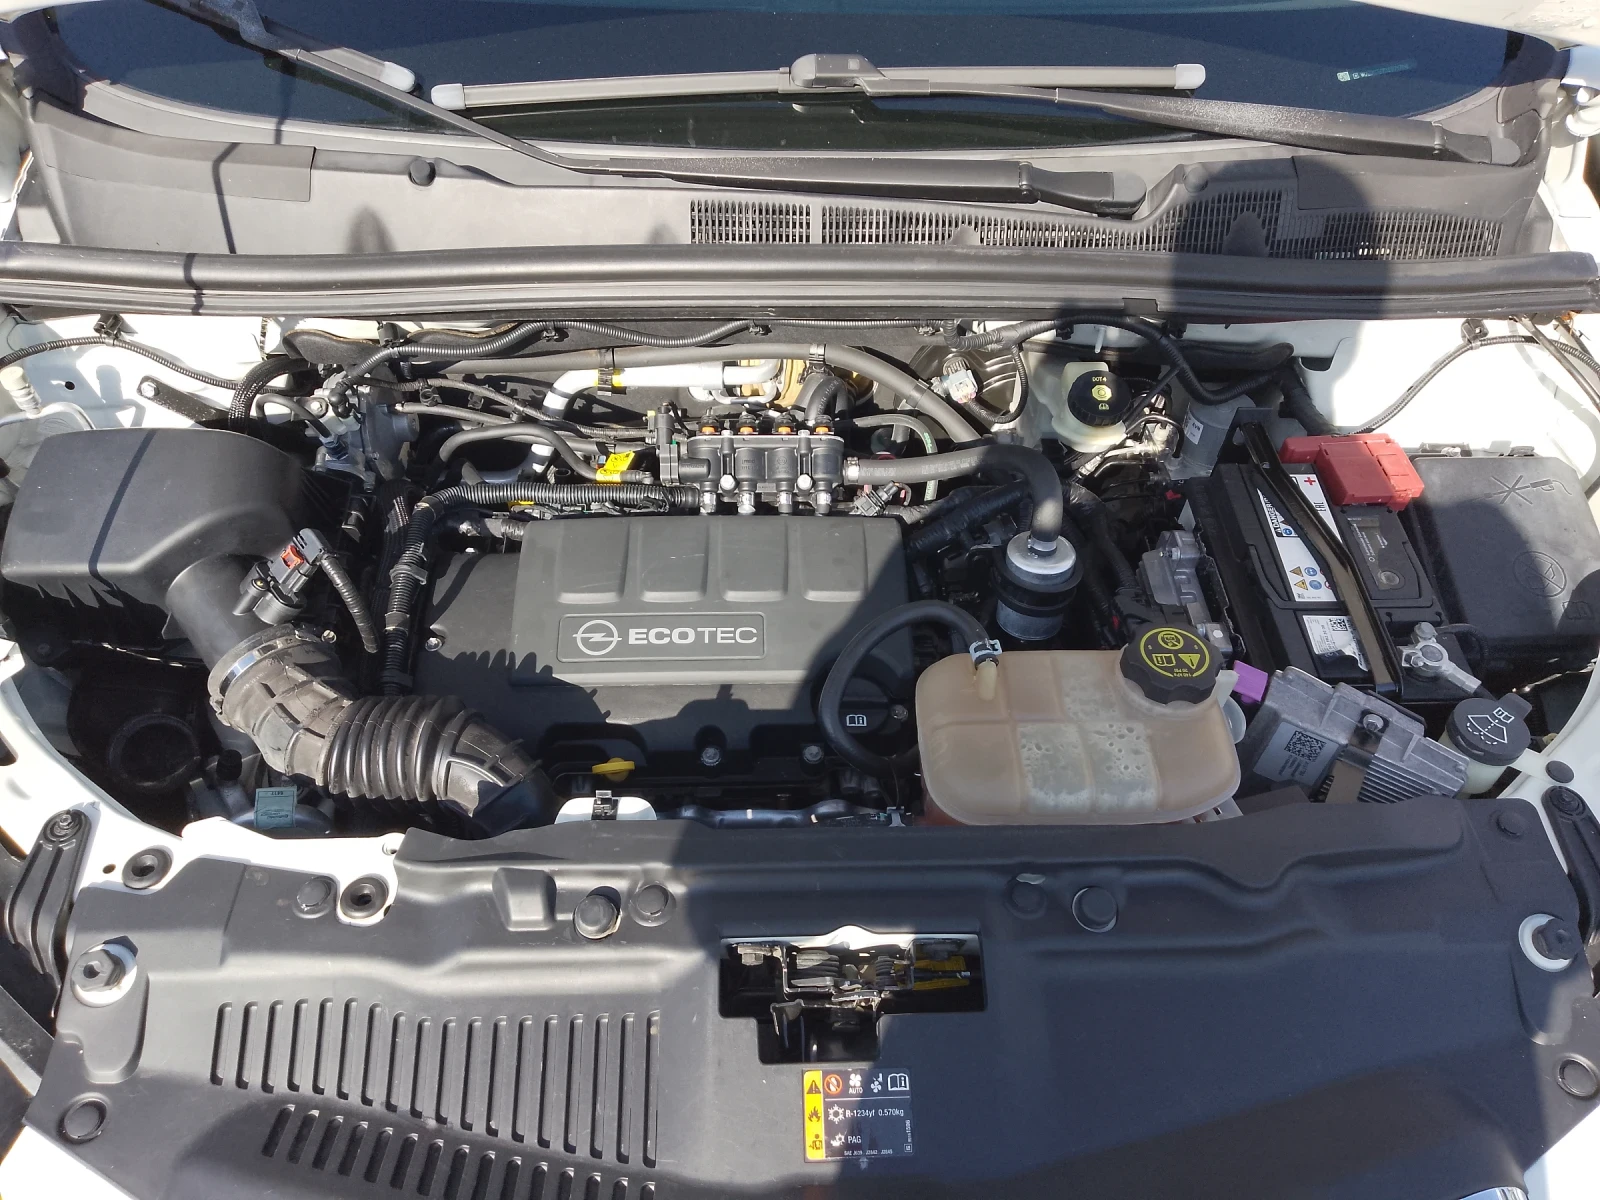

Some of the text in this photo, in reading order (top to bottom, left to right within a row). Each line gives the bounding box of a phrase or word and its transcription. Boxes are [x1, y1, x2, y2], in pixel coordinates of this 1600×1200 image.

[628, 627, 758, 645] ECOTEC
[878, 1108, 904, 1117] 0.570kg
[847, 1135, 861, 1144] PAG
